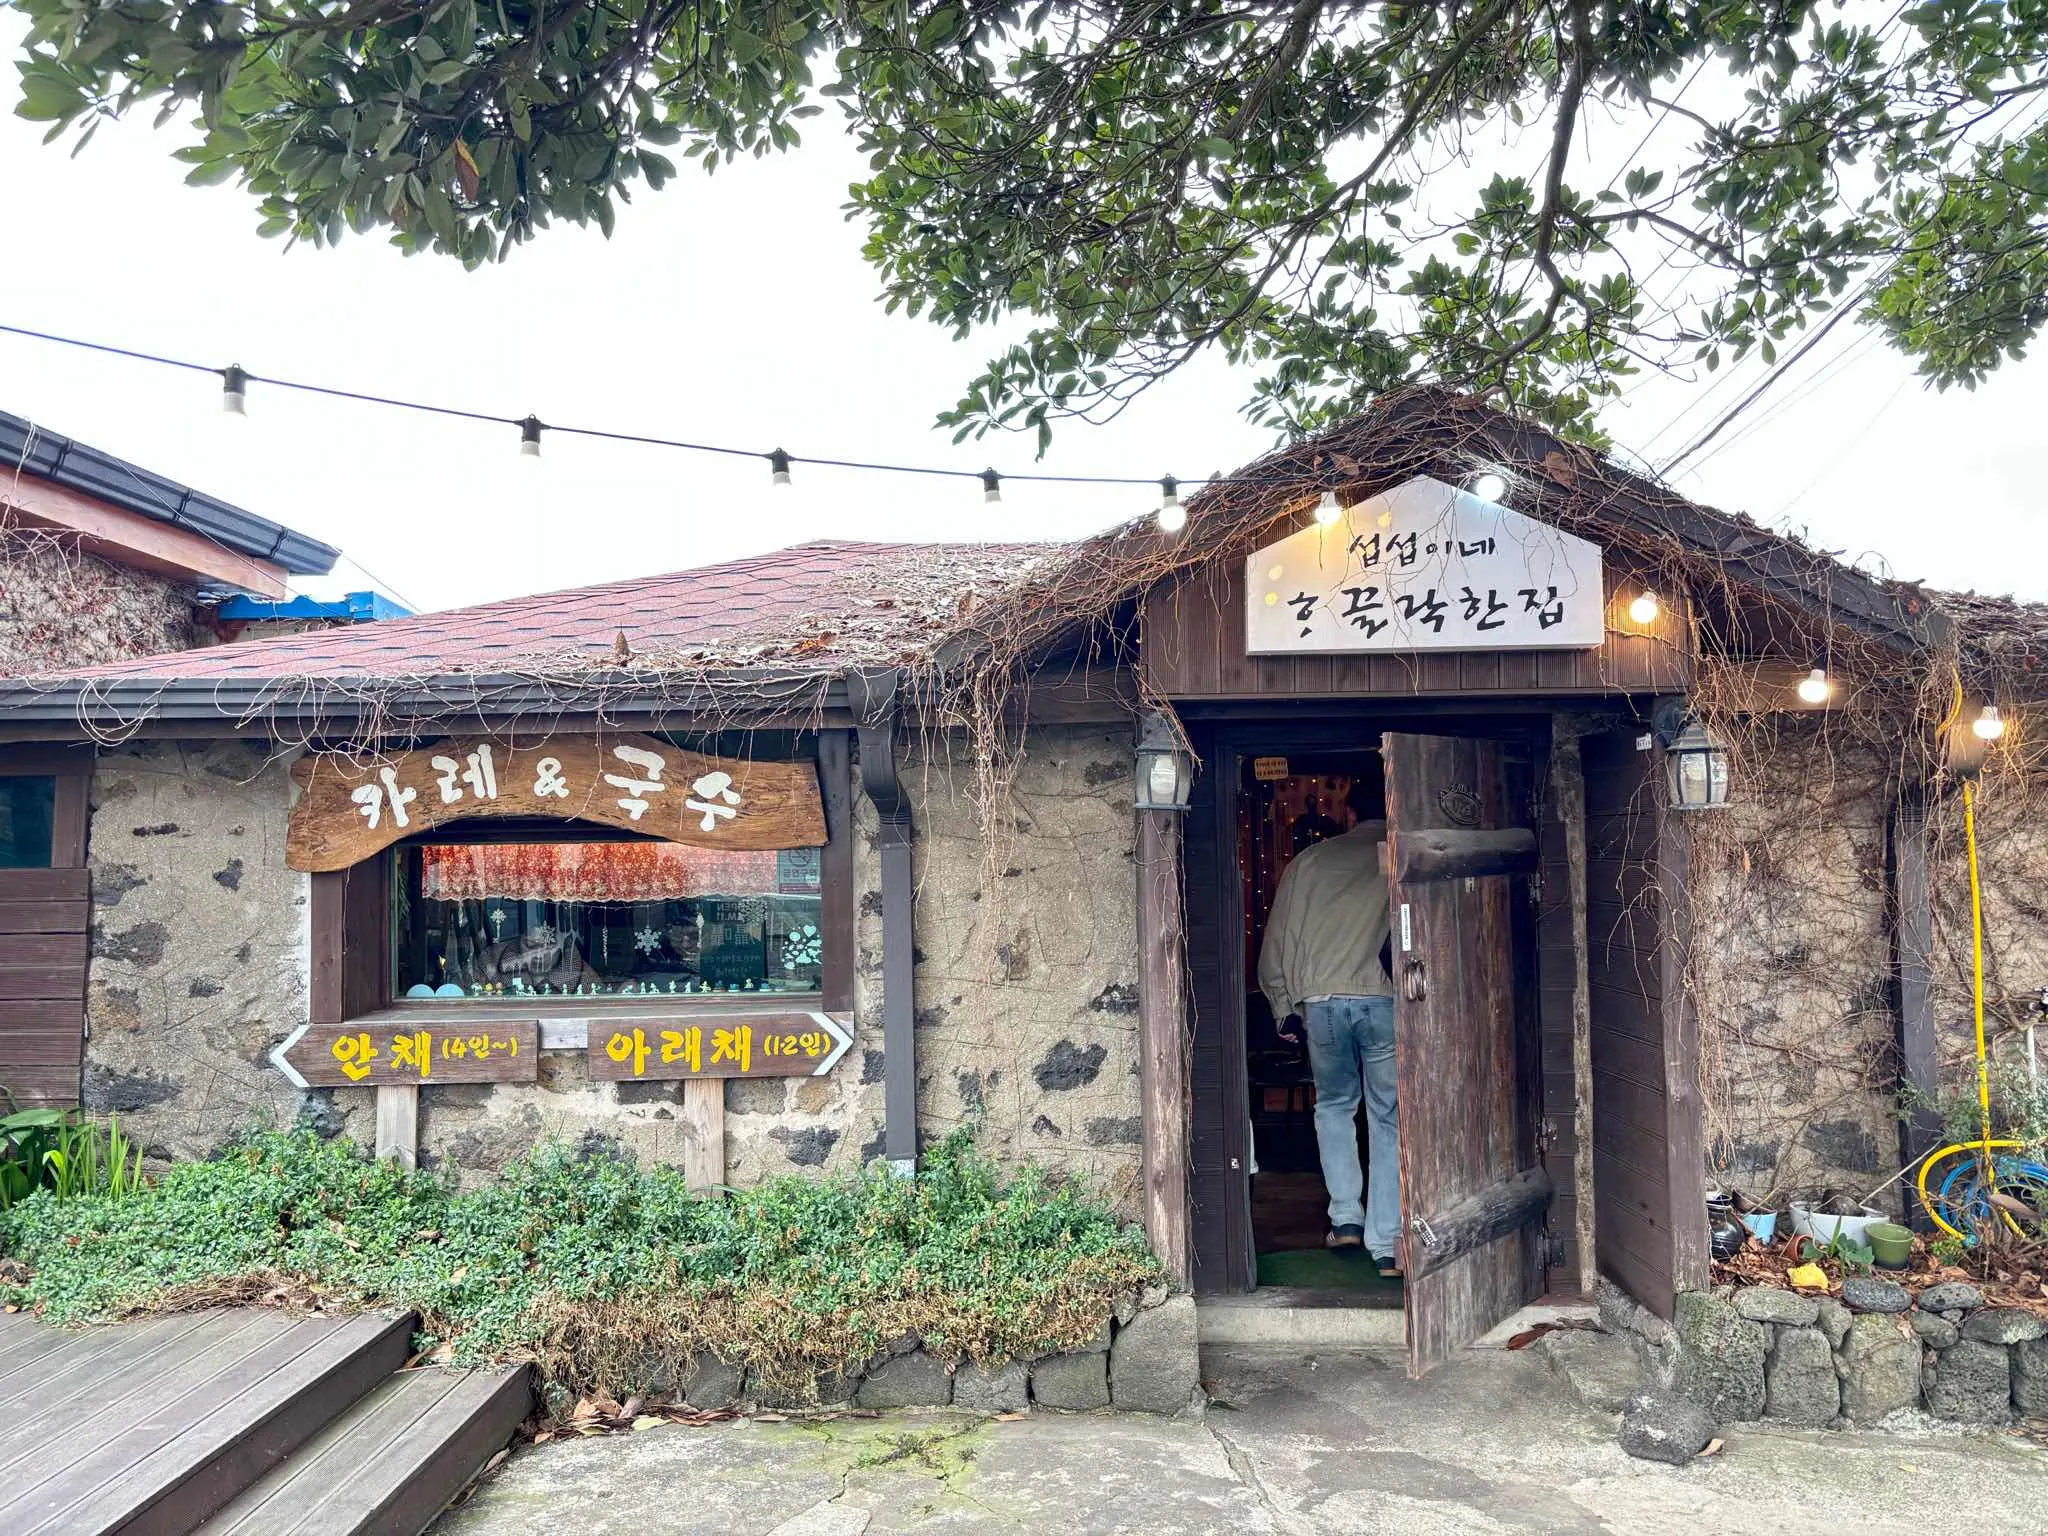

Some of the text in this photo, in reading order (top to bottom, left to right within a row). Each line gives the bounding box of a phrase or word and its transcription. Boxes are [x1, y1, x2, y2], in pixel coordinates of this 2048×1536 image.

[1349, 531, 1496, 569] 섭섭이네
[350, 743, 498, 830] 카레
[533, 757, 570, 798] &
[330, 1031, 518, 1081] 안채 (4인~)
[606, 1026, 753, 1077] 아래채
